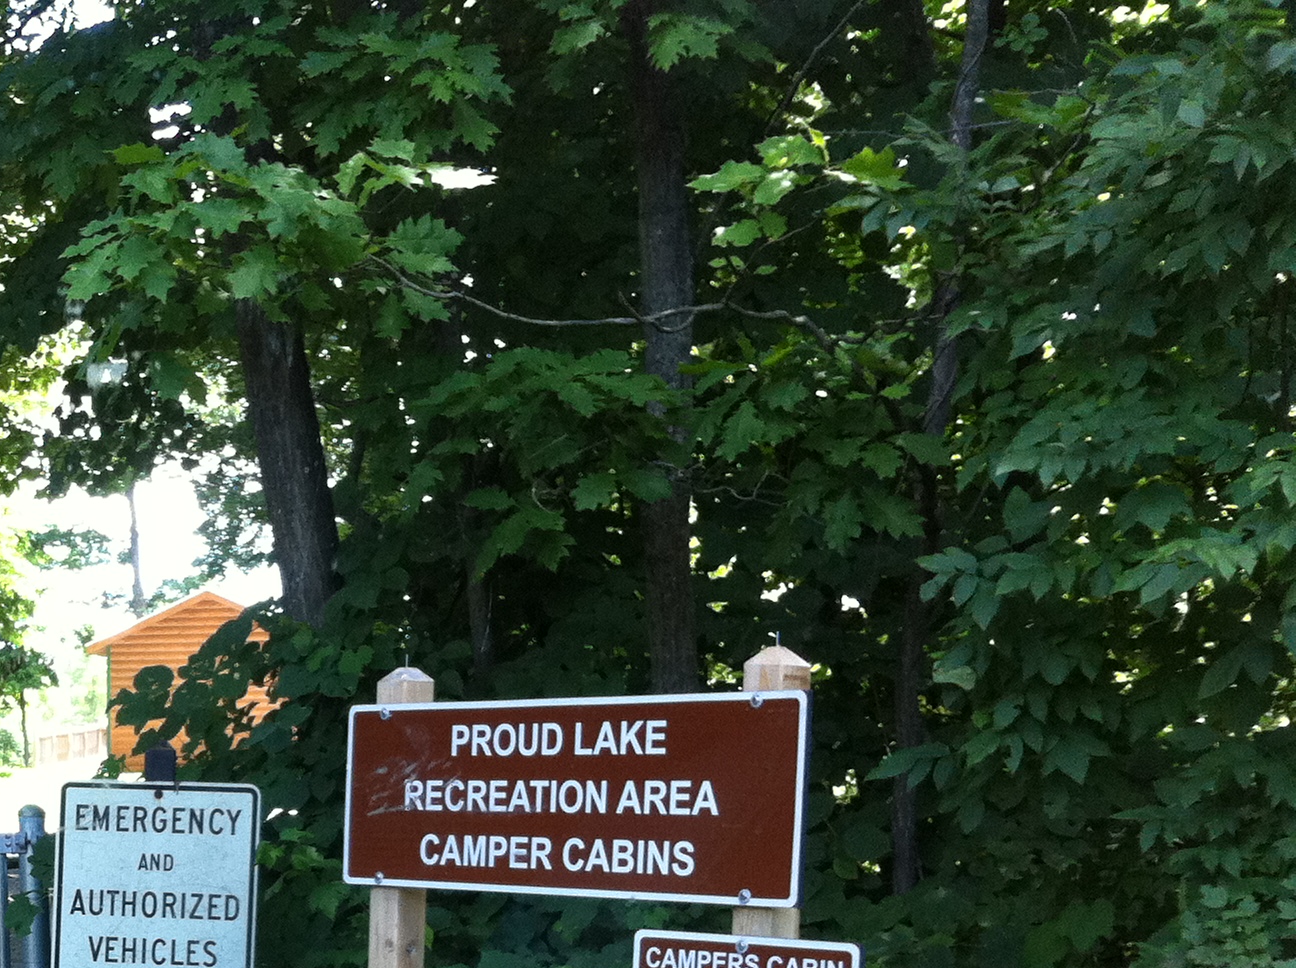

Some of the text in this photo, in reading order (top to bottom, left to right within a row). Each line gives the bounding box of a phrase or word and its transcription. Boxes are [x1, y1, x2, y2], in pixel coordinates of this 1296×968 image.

[451, 720, 667, 756] PROUD LAKE
[404, 780, 719, 815] RECREATION AREA
[75, 804, 242, 836] EMERGENCY
[138, 853, 174, 872] AND
[419, 833, 695, 876] CAMPER CABINS
[70, 889, 240, 921] AUTHORIZED
[88, 936, 218, 968] VEHICLES
